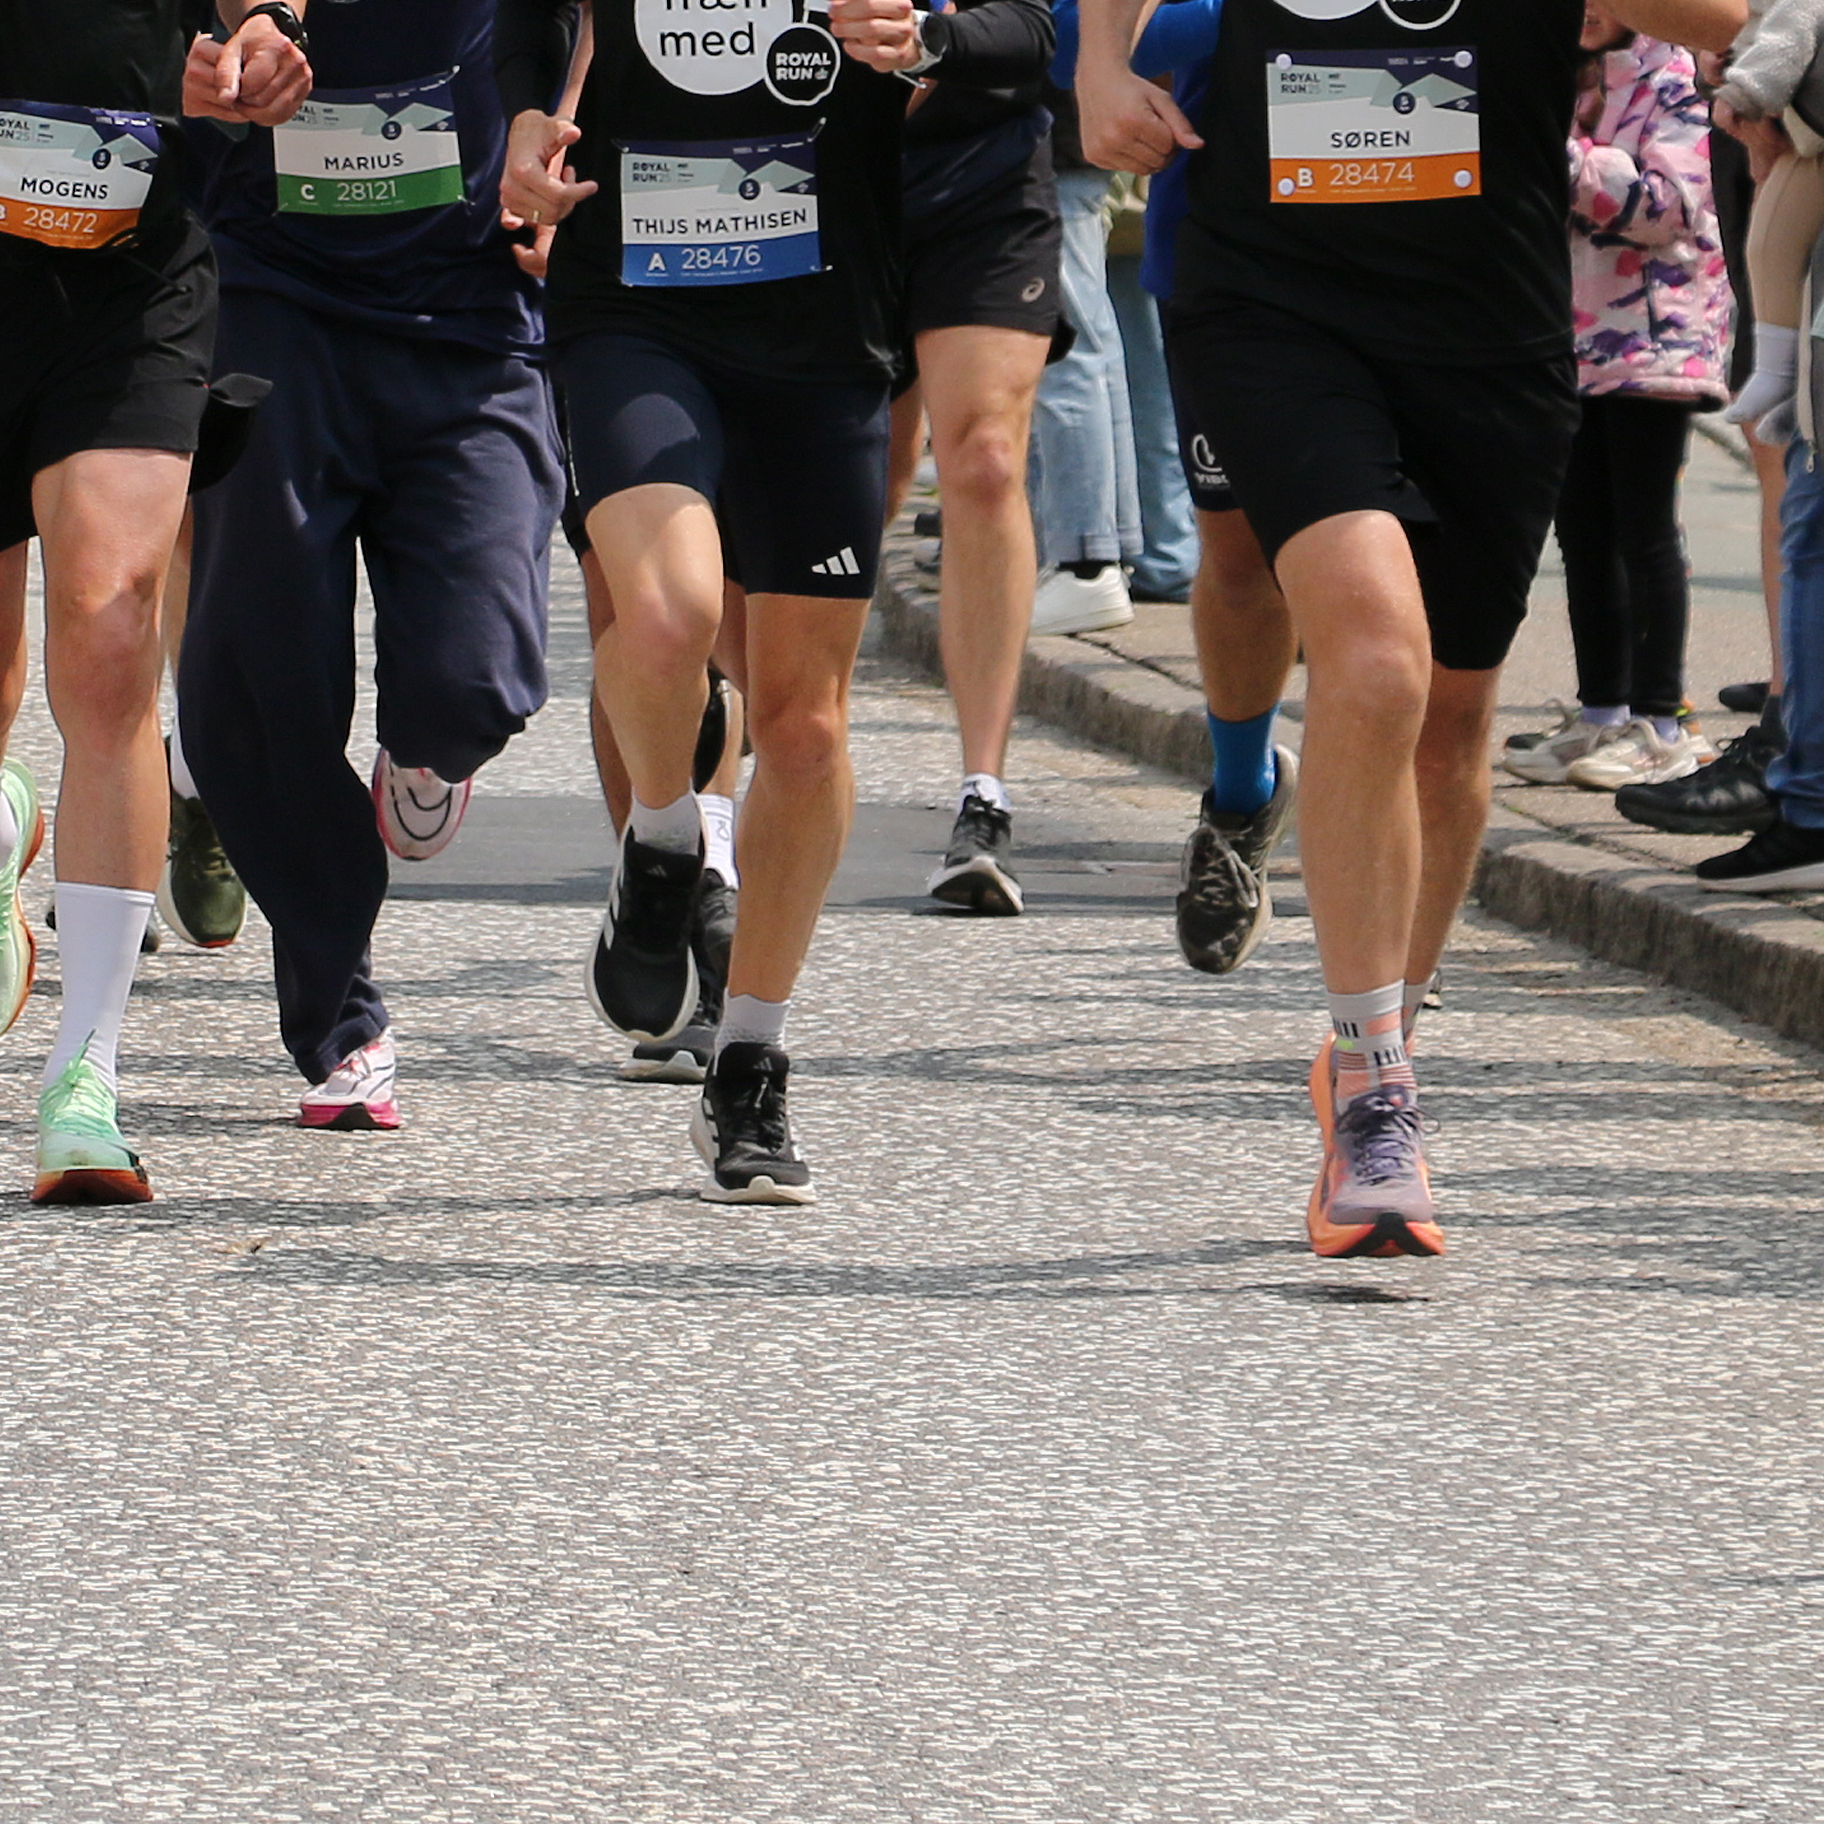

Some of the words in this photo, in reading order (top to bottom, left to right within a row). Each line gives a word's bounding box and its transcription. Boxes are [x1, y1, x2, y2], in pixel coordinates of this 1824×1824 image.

[659, 21, 755, 57] med
[775, 52, 831, 67] ROYAL
[775, 67, 813, 81] RUN
[1331, 130, 1412, 149] SØREN
[324, 152, 404, 171] MARIUS
[1297, 167, 1314, 187] B
[1329, 161, 1415, 186] 28474
[20, 177, 109, 200] MOGENS
[300, 183, 316, 201] C
[337, 180, 397, 201] 28121
[23, 206, 98, 233] 28472
[632, 218, 688, 235] THIJS
[696, 208, 807, 234] MATHISEN
[647, 252, 666, 271] A
[681, 244, 762, 270] 28476
